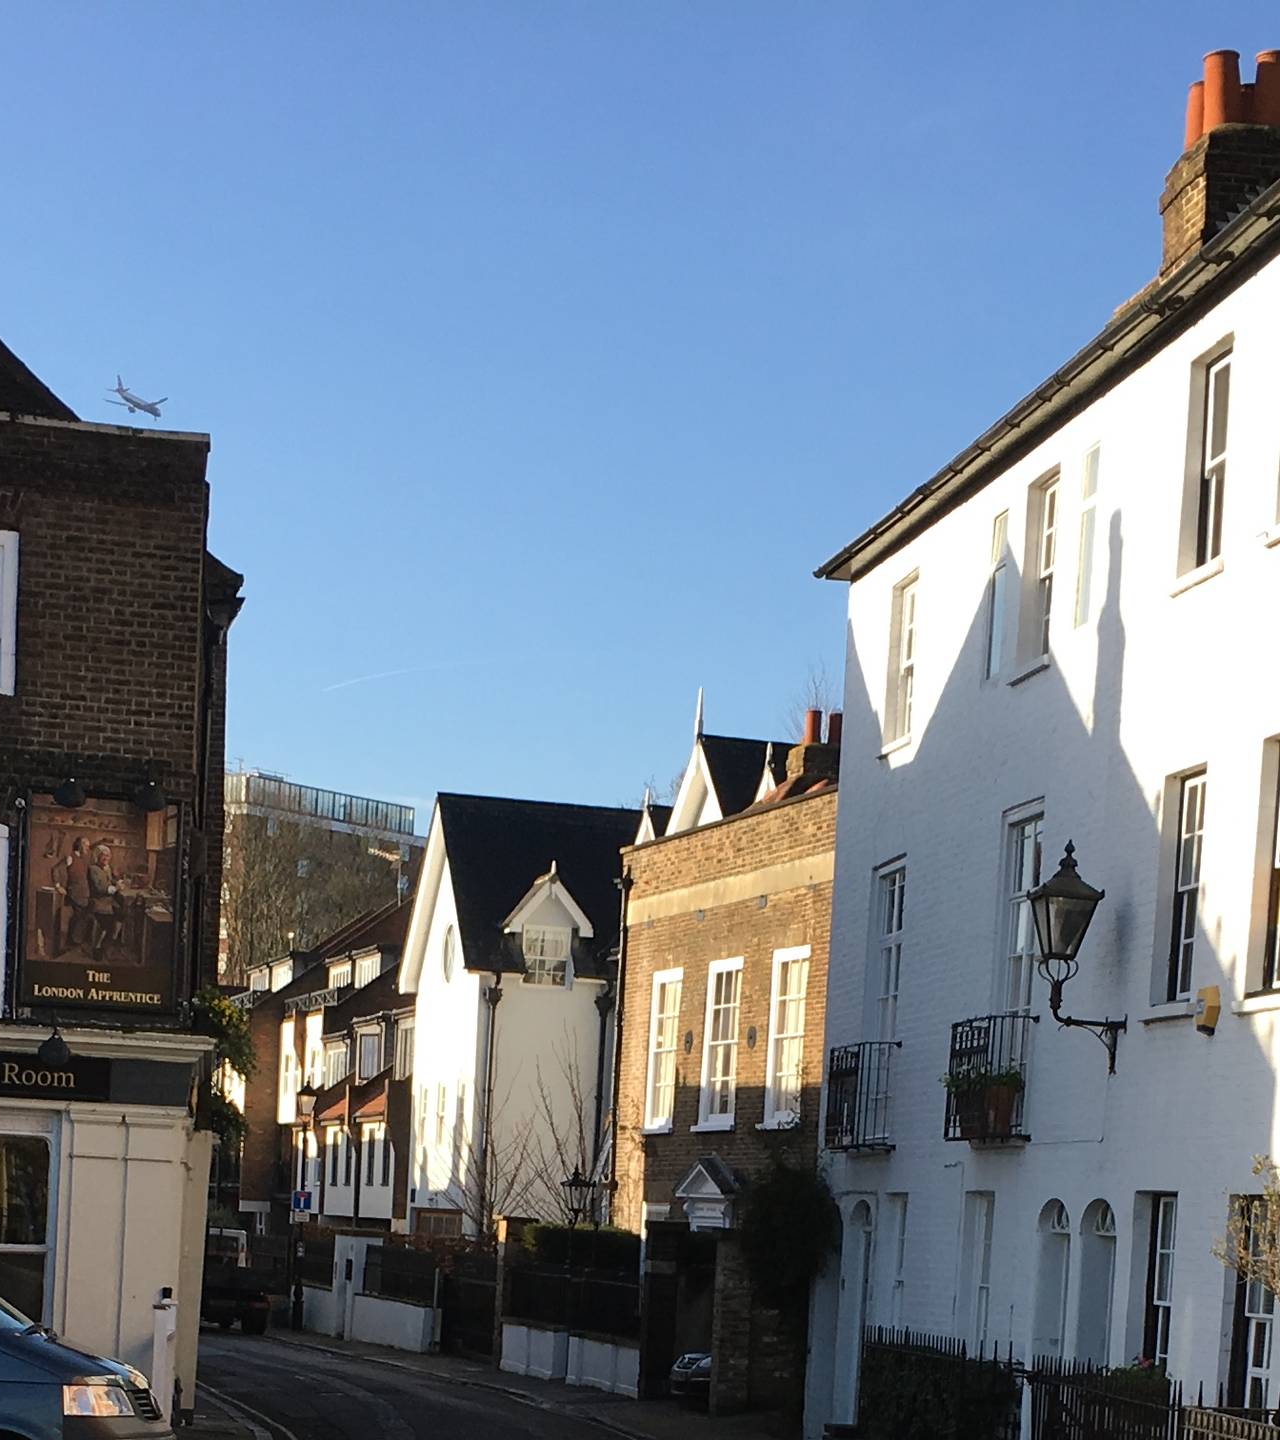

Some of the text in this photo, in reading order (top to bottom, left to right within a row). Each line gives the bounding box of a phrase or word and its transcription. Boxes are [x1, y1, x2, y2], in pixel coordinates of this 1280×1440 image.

[86, 969, 111, 984] THE
[33, 984, 161, 1004] LONDON APPRENTICE
[1, 1061, 76, 1089] Room
